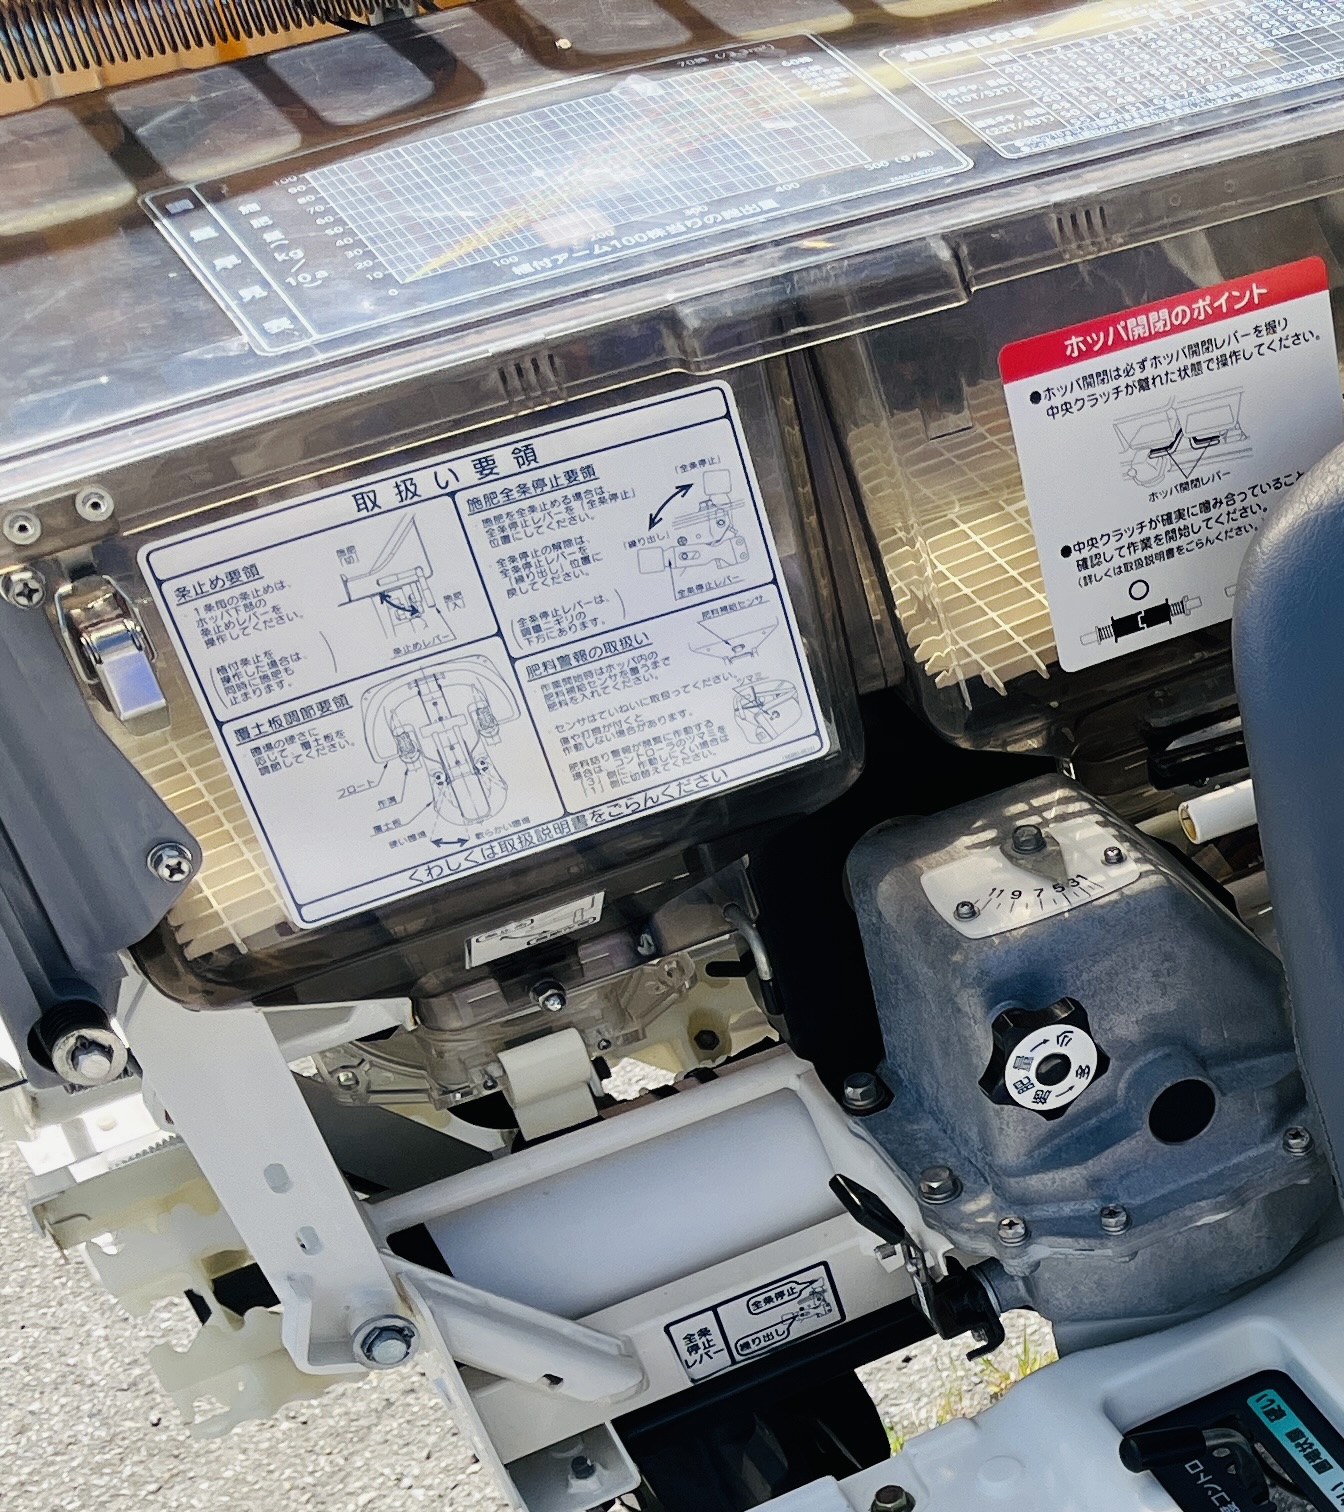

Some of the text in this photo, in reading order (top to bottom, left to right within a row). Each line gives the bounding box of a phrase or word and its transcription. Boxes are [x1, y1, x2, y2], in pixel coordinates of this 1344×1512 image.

[1064, 283, 1268, 359] ホッパ開閉のポイント
[1043, 317, 1289, 402] ホッパ開閉は必ずホッパ開閉レバーを握り
[1045, 328, 1321, 420] 中央クラッチが離れた状態で操作してください。
[352, 441, 541, 514] 取扱い要領
[466, 463, 597, 512] 施肥全条停止要領
[1147, 470, 1232, 503] ホッパ開閉レバー
[1076, 503, 1269, 573] 確認して作業を開始してください。
[174, 563, 261, 602] 条止め要領
[196, 598, 267, 628] ホッパ下部の
[200, 605, 282, 637] 条止めレバーを
[526, 632, 650, 678] 肥料警報の取扱い
[234, 694, 350, 742] 覆土板調節要領
[406, 768, 729, 885] くわしくは取扱説明書をごらんください
[1010, 890, 1022, 899] 9
[1034, 888, 1044, 897] 7
[1053, 883, 1065, 893] 5
[1068, 878, 1080, 887] 3
[1075, 1065, 1090, 1080] 多
[751, 1286, 798, 1311] 全条停止
[682, 1326, 713, 1344] 全条
[686, 1338, 716, 1356] 停止
[739, 1328, 786, 1352] 繰り出し
[684, 1348, 725, 1369] レバー
